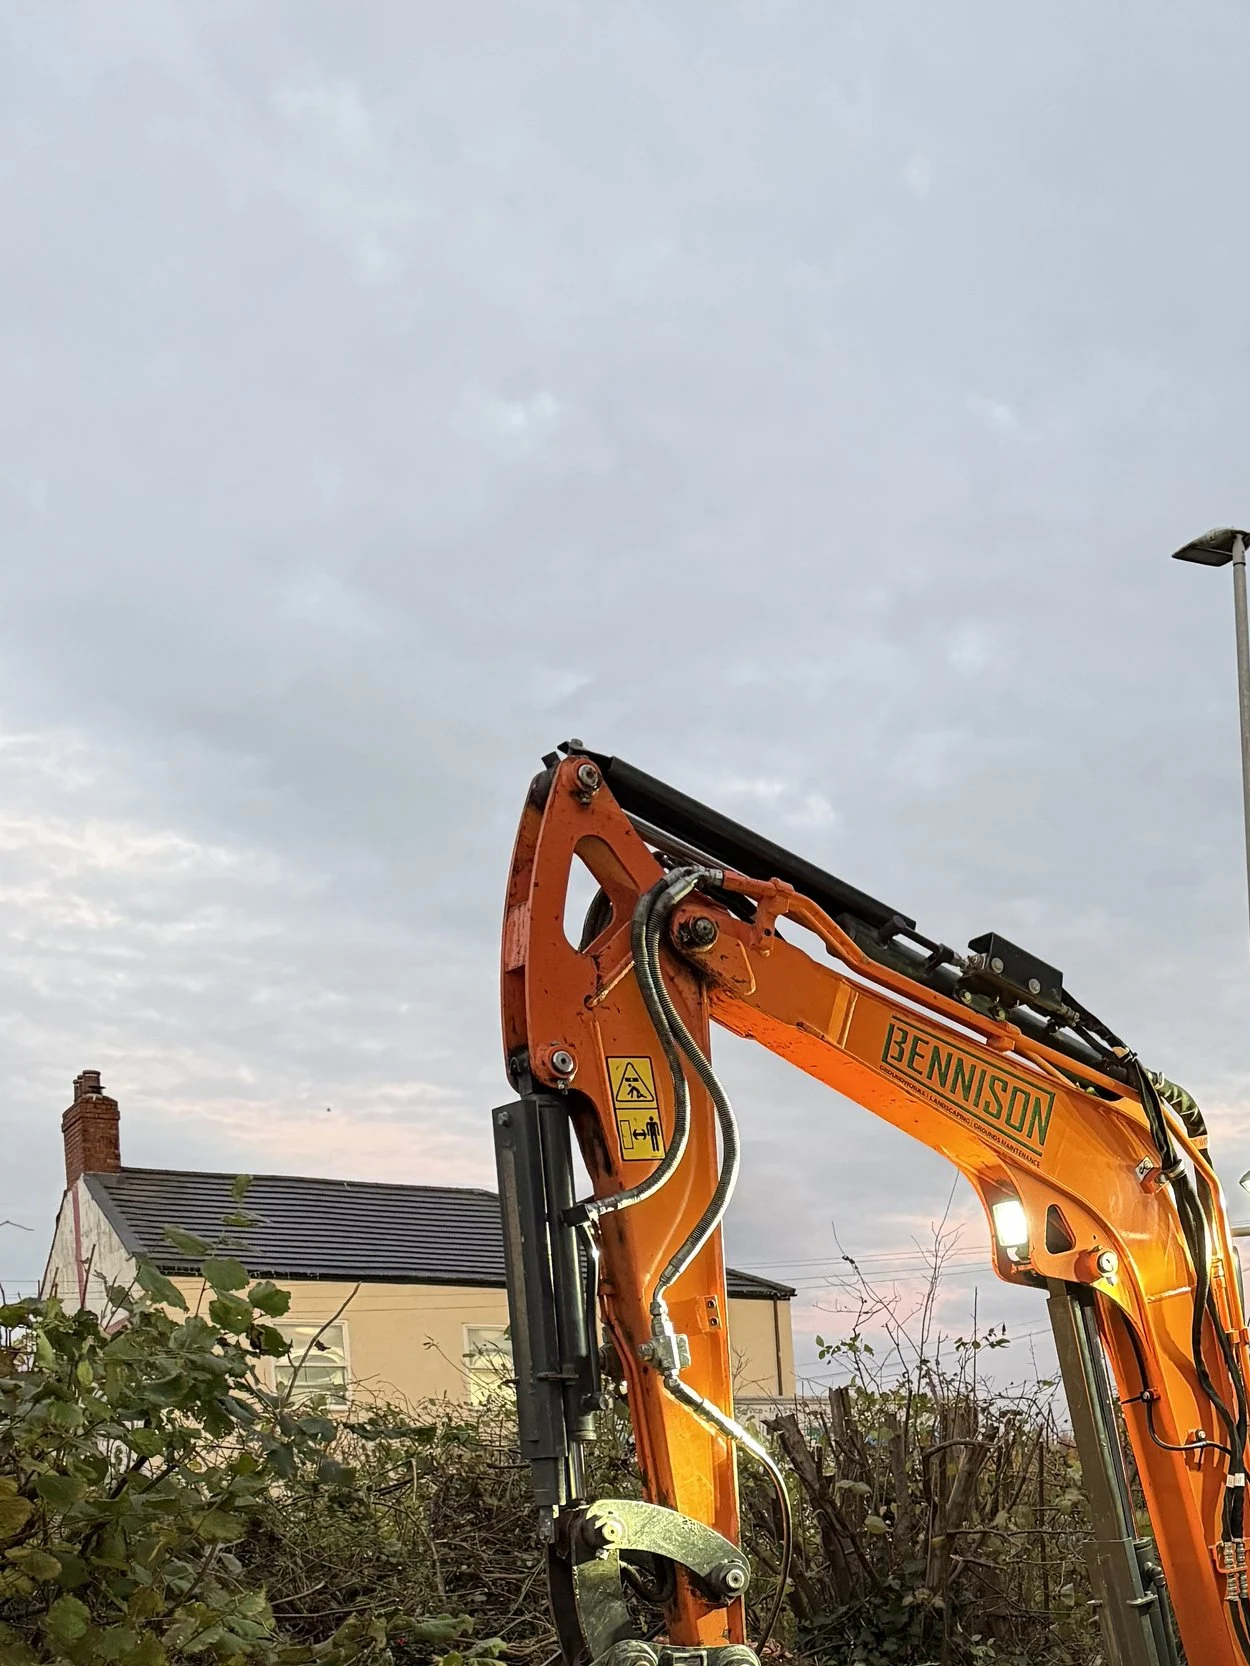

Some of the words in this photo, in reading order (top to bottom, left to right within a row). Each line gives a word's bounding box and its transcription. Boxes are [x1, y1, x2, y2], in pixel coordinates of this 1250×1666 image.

[881, 1023, 1056, 1146] BENNISON
[929, 1095, 971, 1125] LANDSCAPING
[973, 1122, 1001, 1143] GROUNDS
[1000, 1139, 1041, 1168] MAINTENANCE
